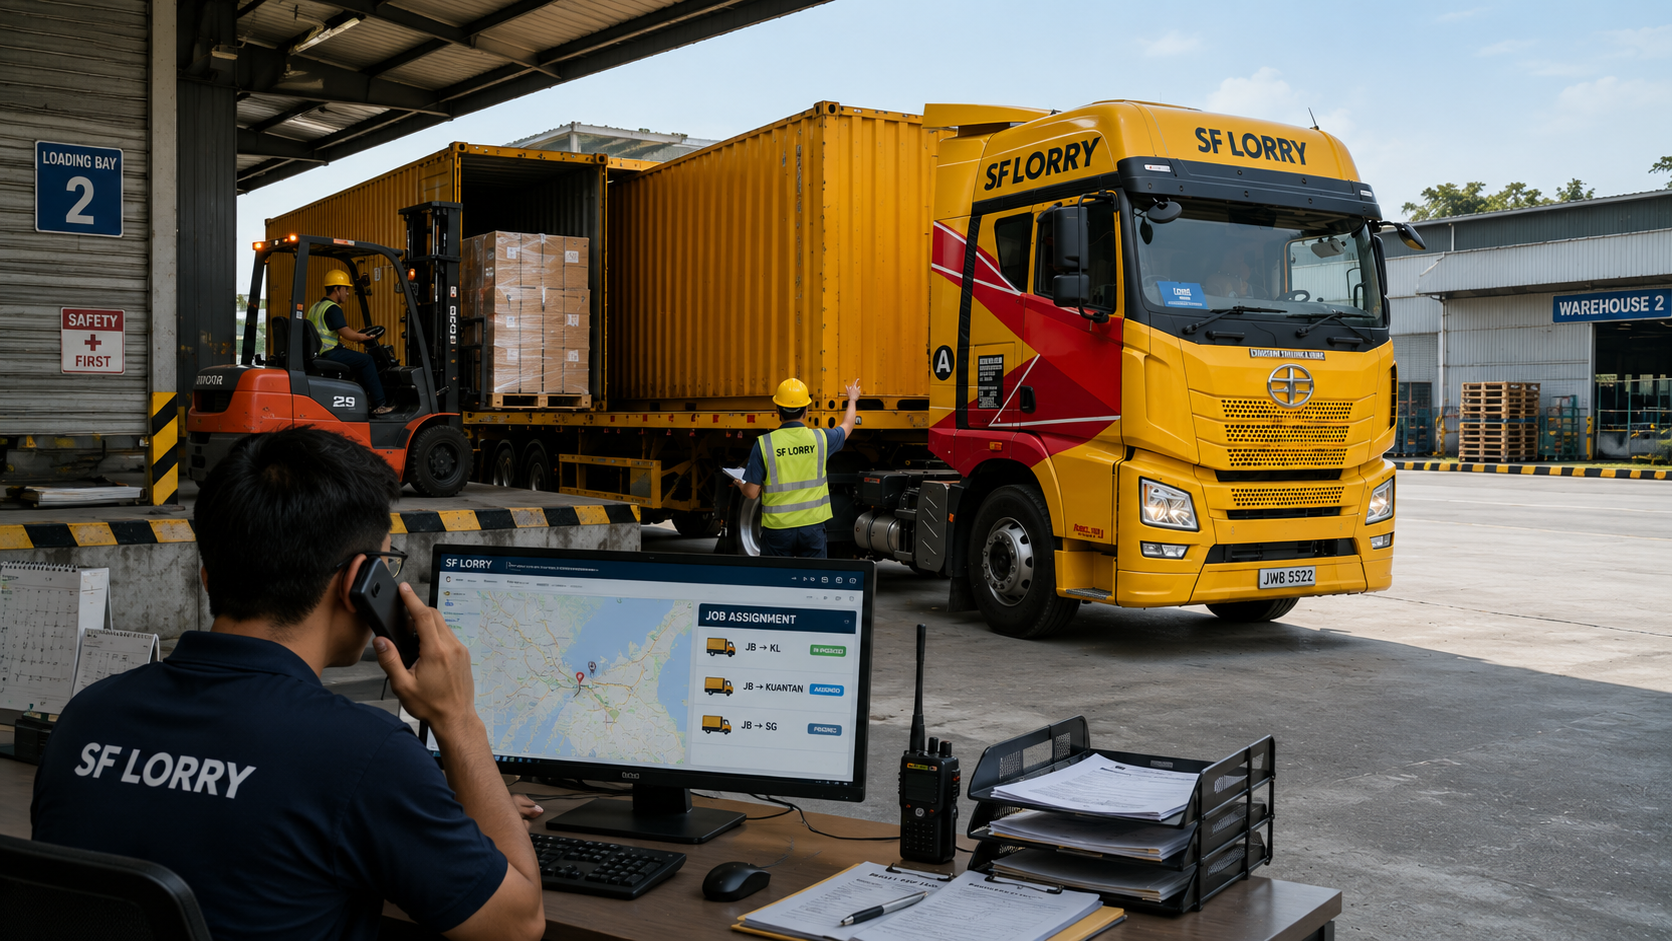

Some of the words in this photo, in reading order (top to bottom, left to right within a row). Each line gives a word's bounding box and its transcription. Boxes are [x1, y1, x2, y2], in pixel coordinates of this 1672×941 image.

[1195, 127, 1222, 154] SF
[1227, 131, 1306, 165] LORRY
[43, 151, 91, 169] LOADING
[95, 156, 117, 170] BAY
[65, 176, 95, 225] 2
[1559, 296, 1649, 316] WAREHOUSE
[1654, 295, 1664, 311] 2
[68, 313, 118, 328] SAFETY
[75, 355, 111, 368] FIRST
[936, 349, 951, 373] A
[332, 395, 356, 408] 29
[776, 448, 787, 457] SF
[788, 445, 815, 456] LORRY
[445, 558, 458, 568] SF
[460, 559, 493, 570] LORRY
[1263, 571, 1285, 585] JWB
[705, 610, 726, 622] JOB
[728, 611, 797, 625] ASSIGNMENT
[745, 642, 757, 652] JB
[769, 643, 781, 653] KL
[743, 682, 754, 691] JB
[765, 683, 804, 693] KUANTAN
[741, 721, 752, 730] JB
[765, 722, 777, 731] SG
[74, 742, 123, 779] SF
[120, 748, 257, 799] LORRY
